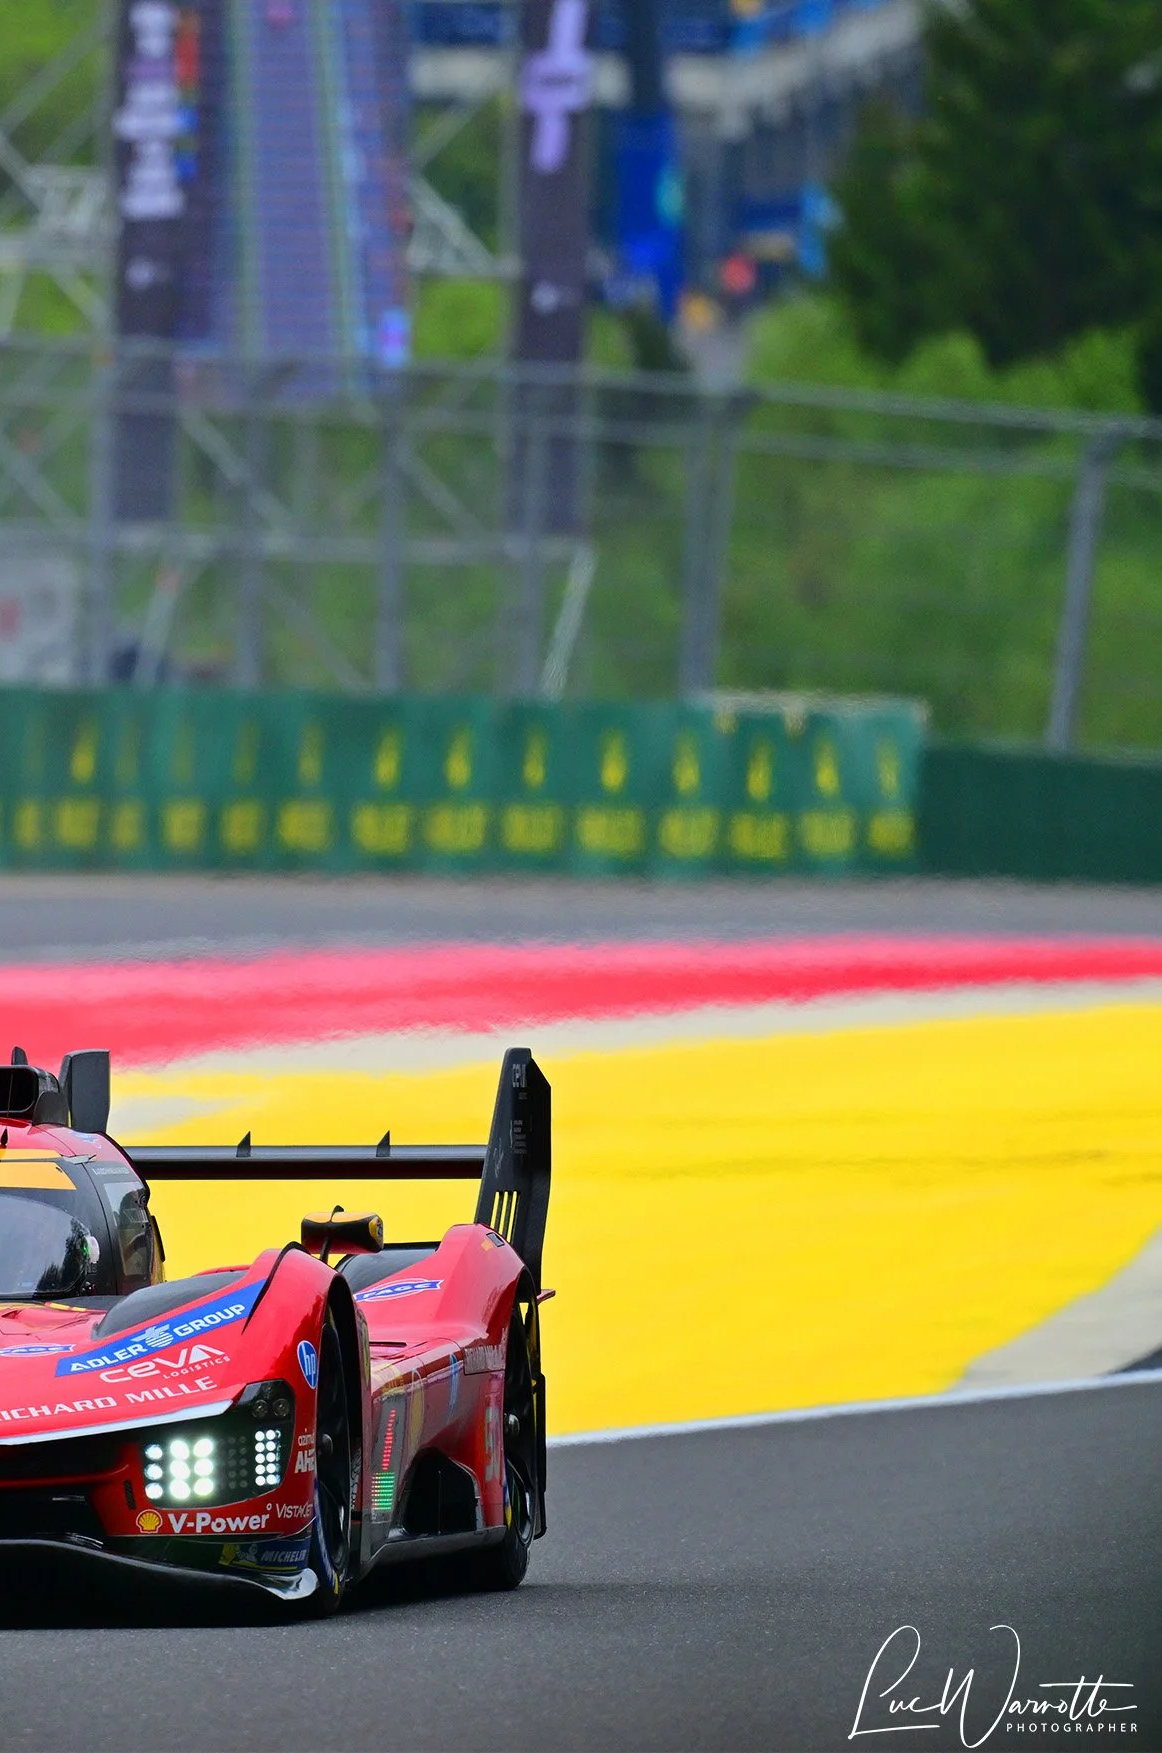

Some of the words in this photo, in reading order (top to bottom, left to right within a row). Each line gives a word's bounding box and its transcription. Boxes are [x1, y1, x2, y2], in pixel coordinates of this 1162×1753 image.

[70, 1343, 148, 1373] ADLER
[173, 1303, 246, 1337] GROUP
[163, 1356, 231, 1379] LOGISTICS
[301, 1342, 316, 1387] hp
[125, 1376, 218, 1404] MILLE
[168, 1512, 269, 1533] V-Power
